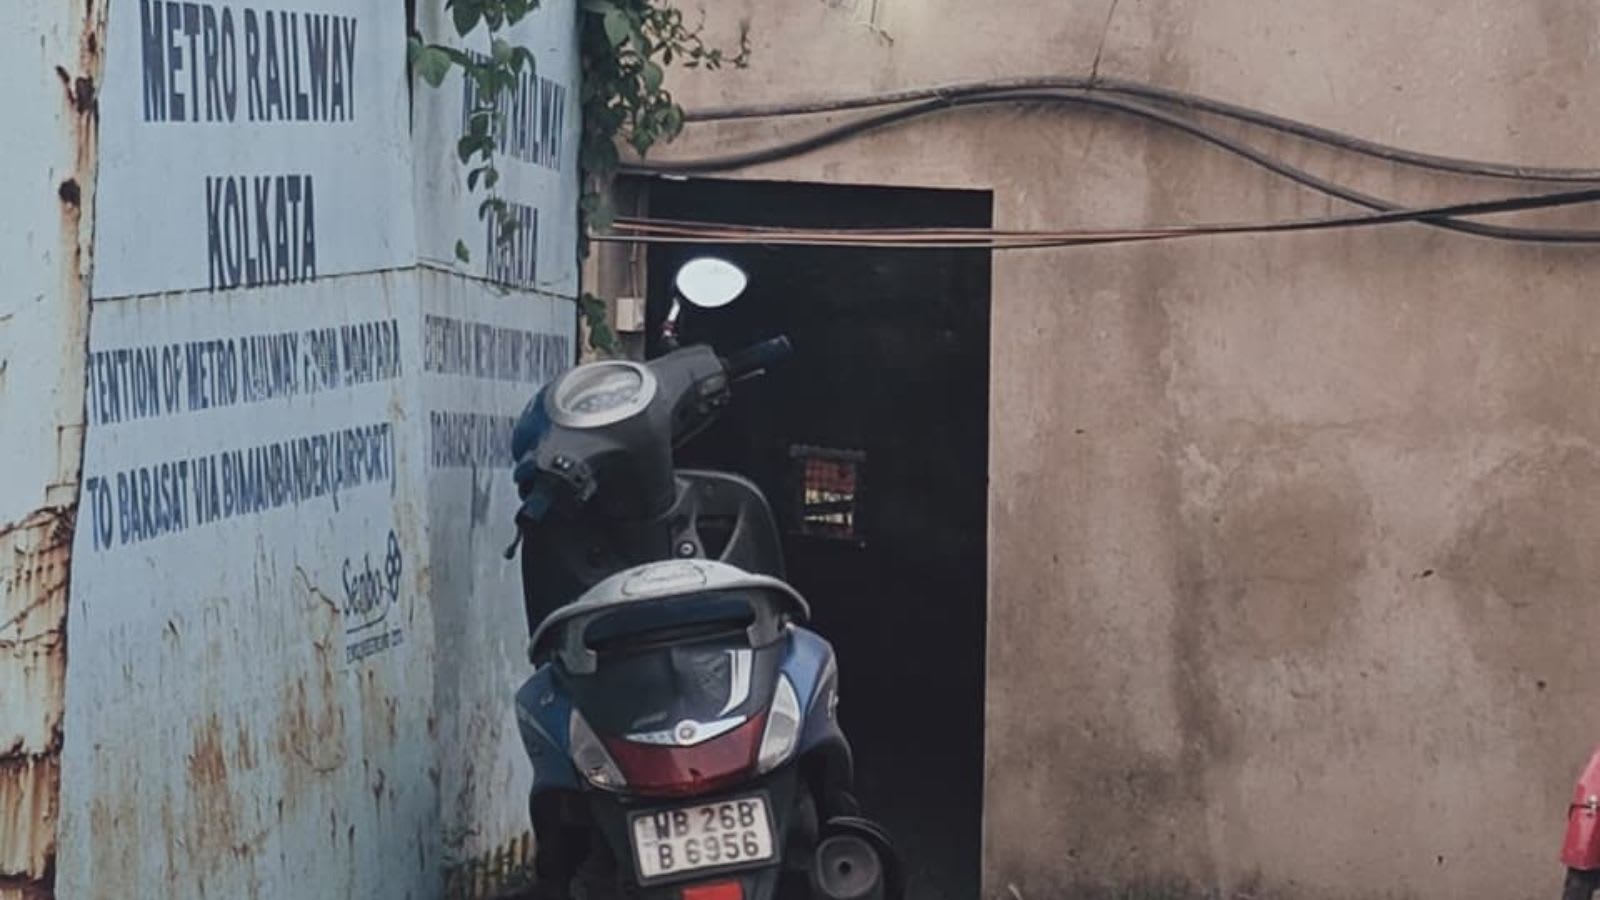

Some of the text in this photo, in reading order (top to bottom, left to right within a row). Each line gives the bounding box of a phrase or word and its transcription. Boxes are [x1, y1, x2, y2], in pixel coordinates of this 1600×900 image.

[140, 0, 238, 123] METRO
[244, 8, 357, 122] RAILWAY
[205, 174, 316, 292] KOLKATA
[162, 342, 184, 414] OF
[185, 338, 238, 411] METRO
[239, 331, 299, 403] RAILWAY
[86, 472, 114, 552] TO
[116, 460, 189, 546] BARASAT
[190, 453, 222, 526] VIA
[653, 801, 756, 840] WB 26B
[657, 830, 759, 869] B 6956
